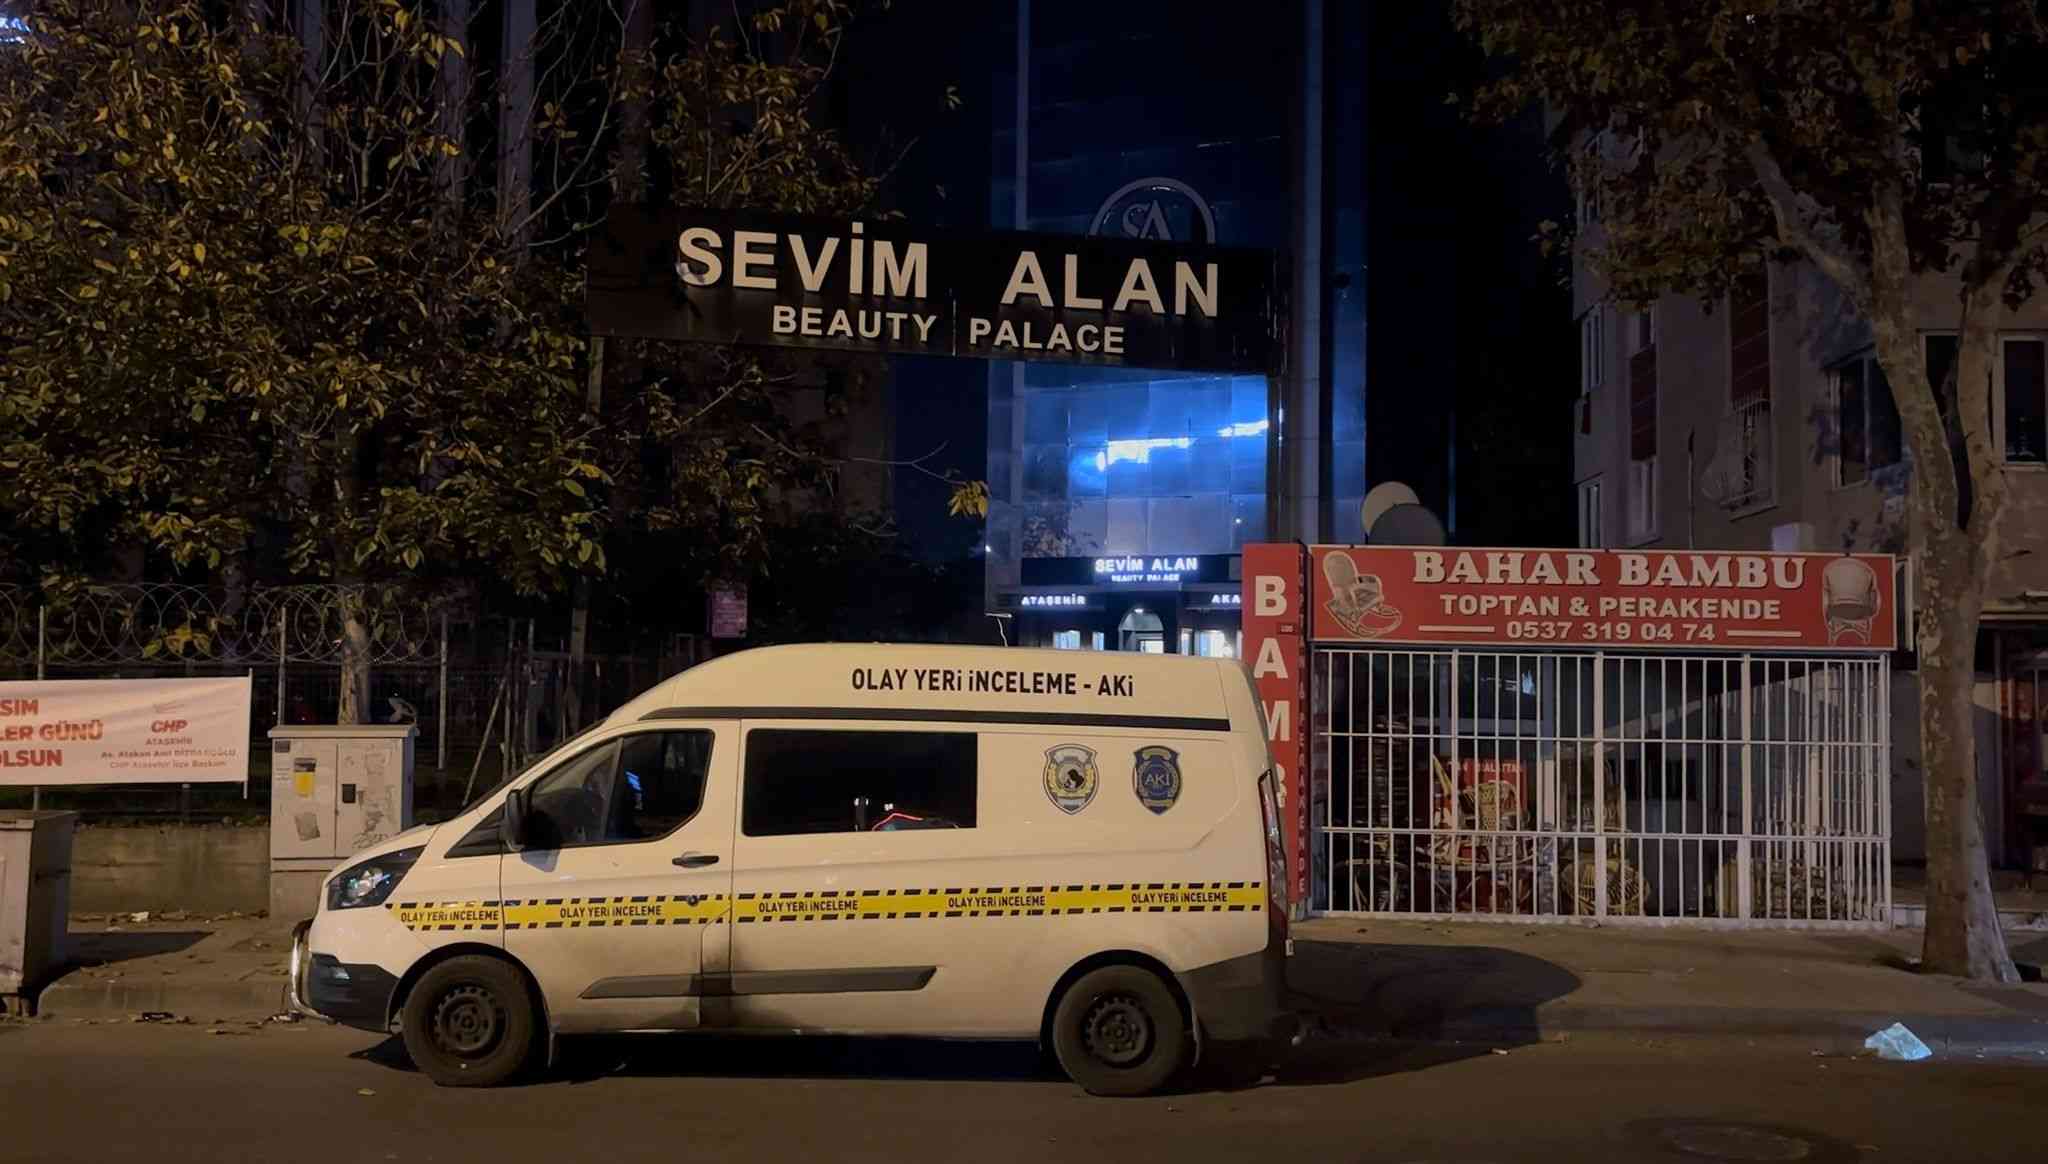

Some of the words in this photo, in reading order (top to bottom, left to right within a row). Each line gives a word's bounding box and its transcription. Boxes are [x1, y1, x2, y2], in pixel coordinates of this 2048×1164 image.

[676, 221, 928, 298] SEVİM
[1001, 250, 1218, 317] ALAN
[772, 305, 937, 342] BEAUTY
[969, 317, 1124, 354] PALACE
[1095, 555, 1144, 573] SEVİM
[1151, 557, 1198, 572] ALAN
[1412, 550, 1600, 585] BAHAR
[1618, 553, 1807, 589] BAMBU
[1440, 594, 1559, 616] TOPTAN
[1569, 596, 1590, 618] &
[1599, 597, 1781, 620] PERAKENDE
[1506, 620, 1573, 639] 0537
[1582, 621, 1632, 640] 319
[1640, 622, 1674, 641] 04
[1681, 623, 1716, 641] 74
[852, 668, 908, 690] OLAY
[39, 719, 103, 741] GÜNÜ
[151, 719, 188, 733] CHP
[758, 902, 784, 913] OLAY
[948, 898, 974, 908] OLAY
[1131, 894, 1157, 905] OLAY
[400, 908, 423, 922] OLAY
[559, 907, 586, 919] OLAY
